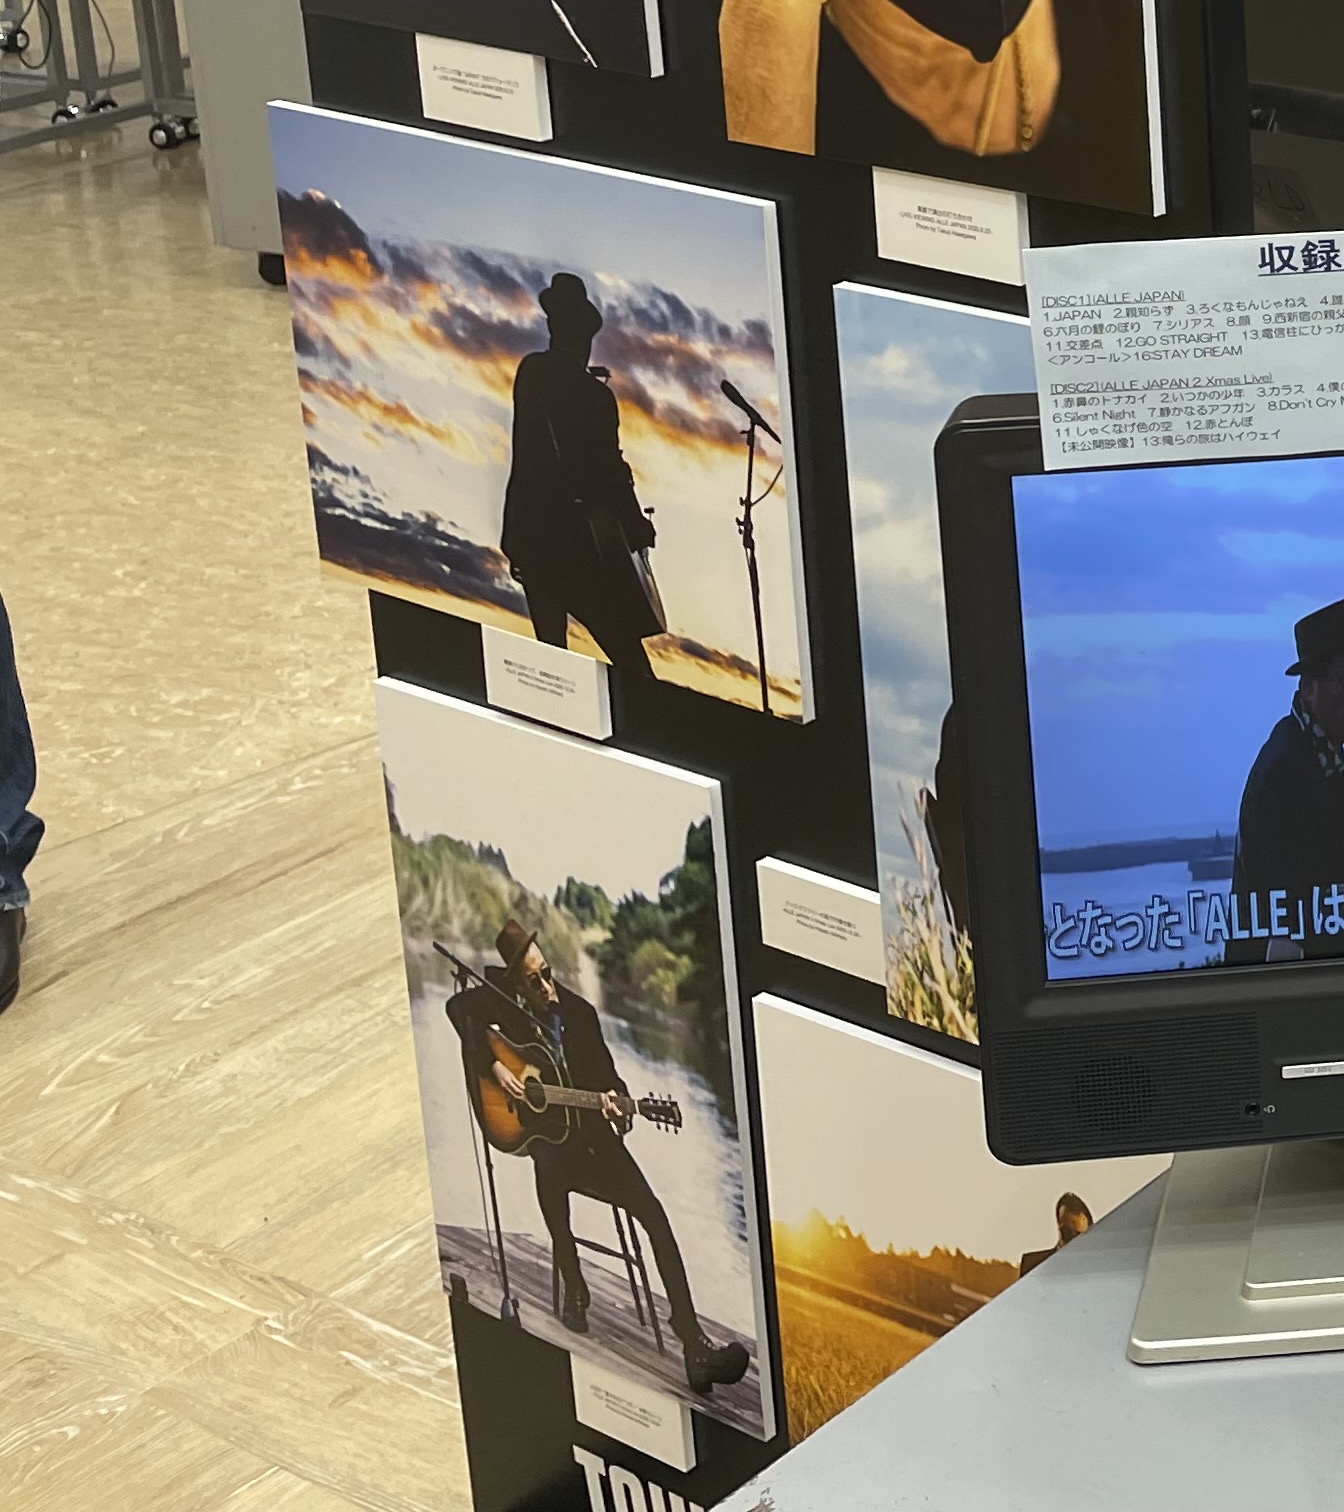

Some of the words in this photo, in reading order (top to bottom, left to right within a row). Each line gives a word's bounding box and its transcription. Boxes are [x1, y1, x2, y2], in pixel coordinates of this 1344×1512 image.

[1159, 331, 1228, 346] STRAIGHT
[1193, 345, 1243, 359] DREAM
[1142, 378, 1190, 391] JAPAN
[1102, 409, 1136, 423] Night
[1316, 397, 1337, 410] Cry
